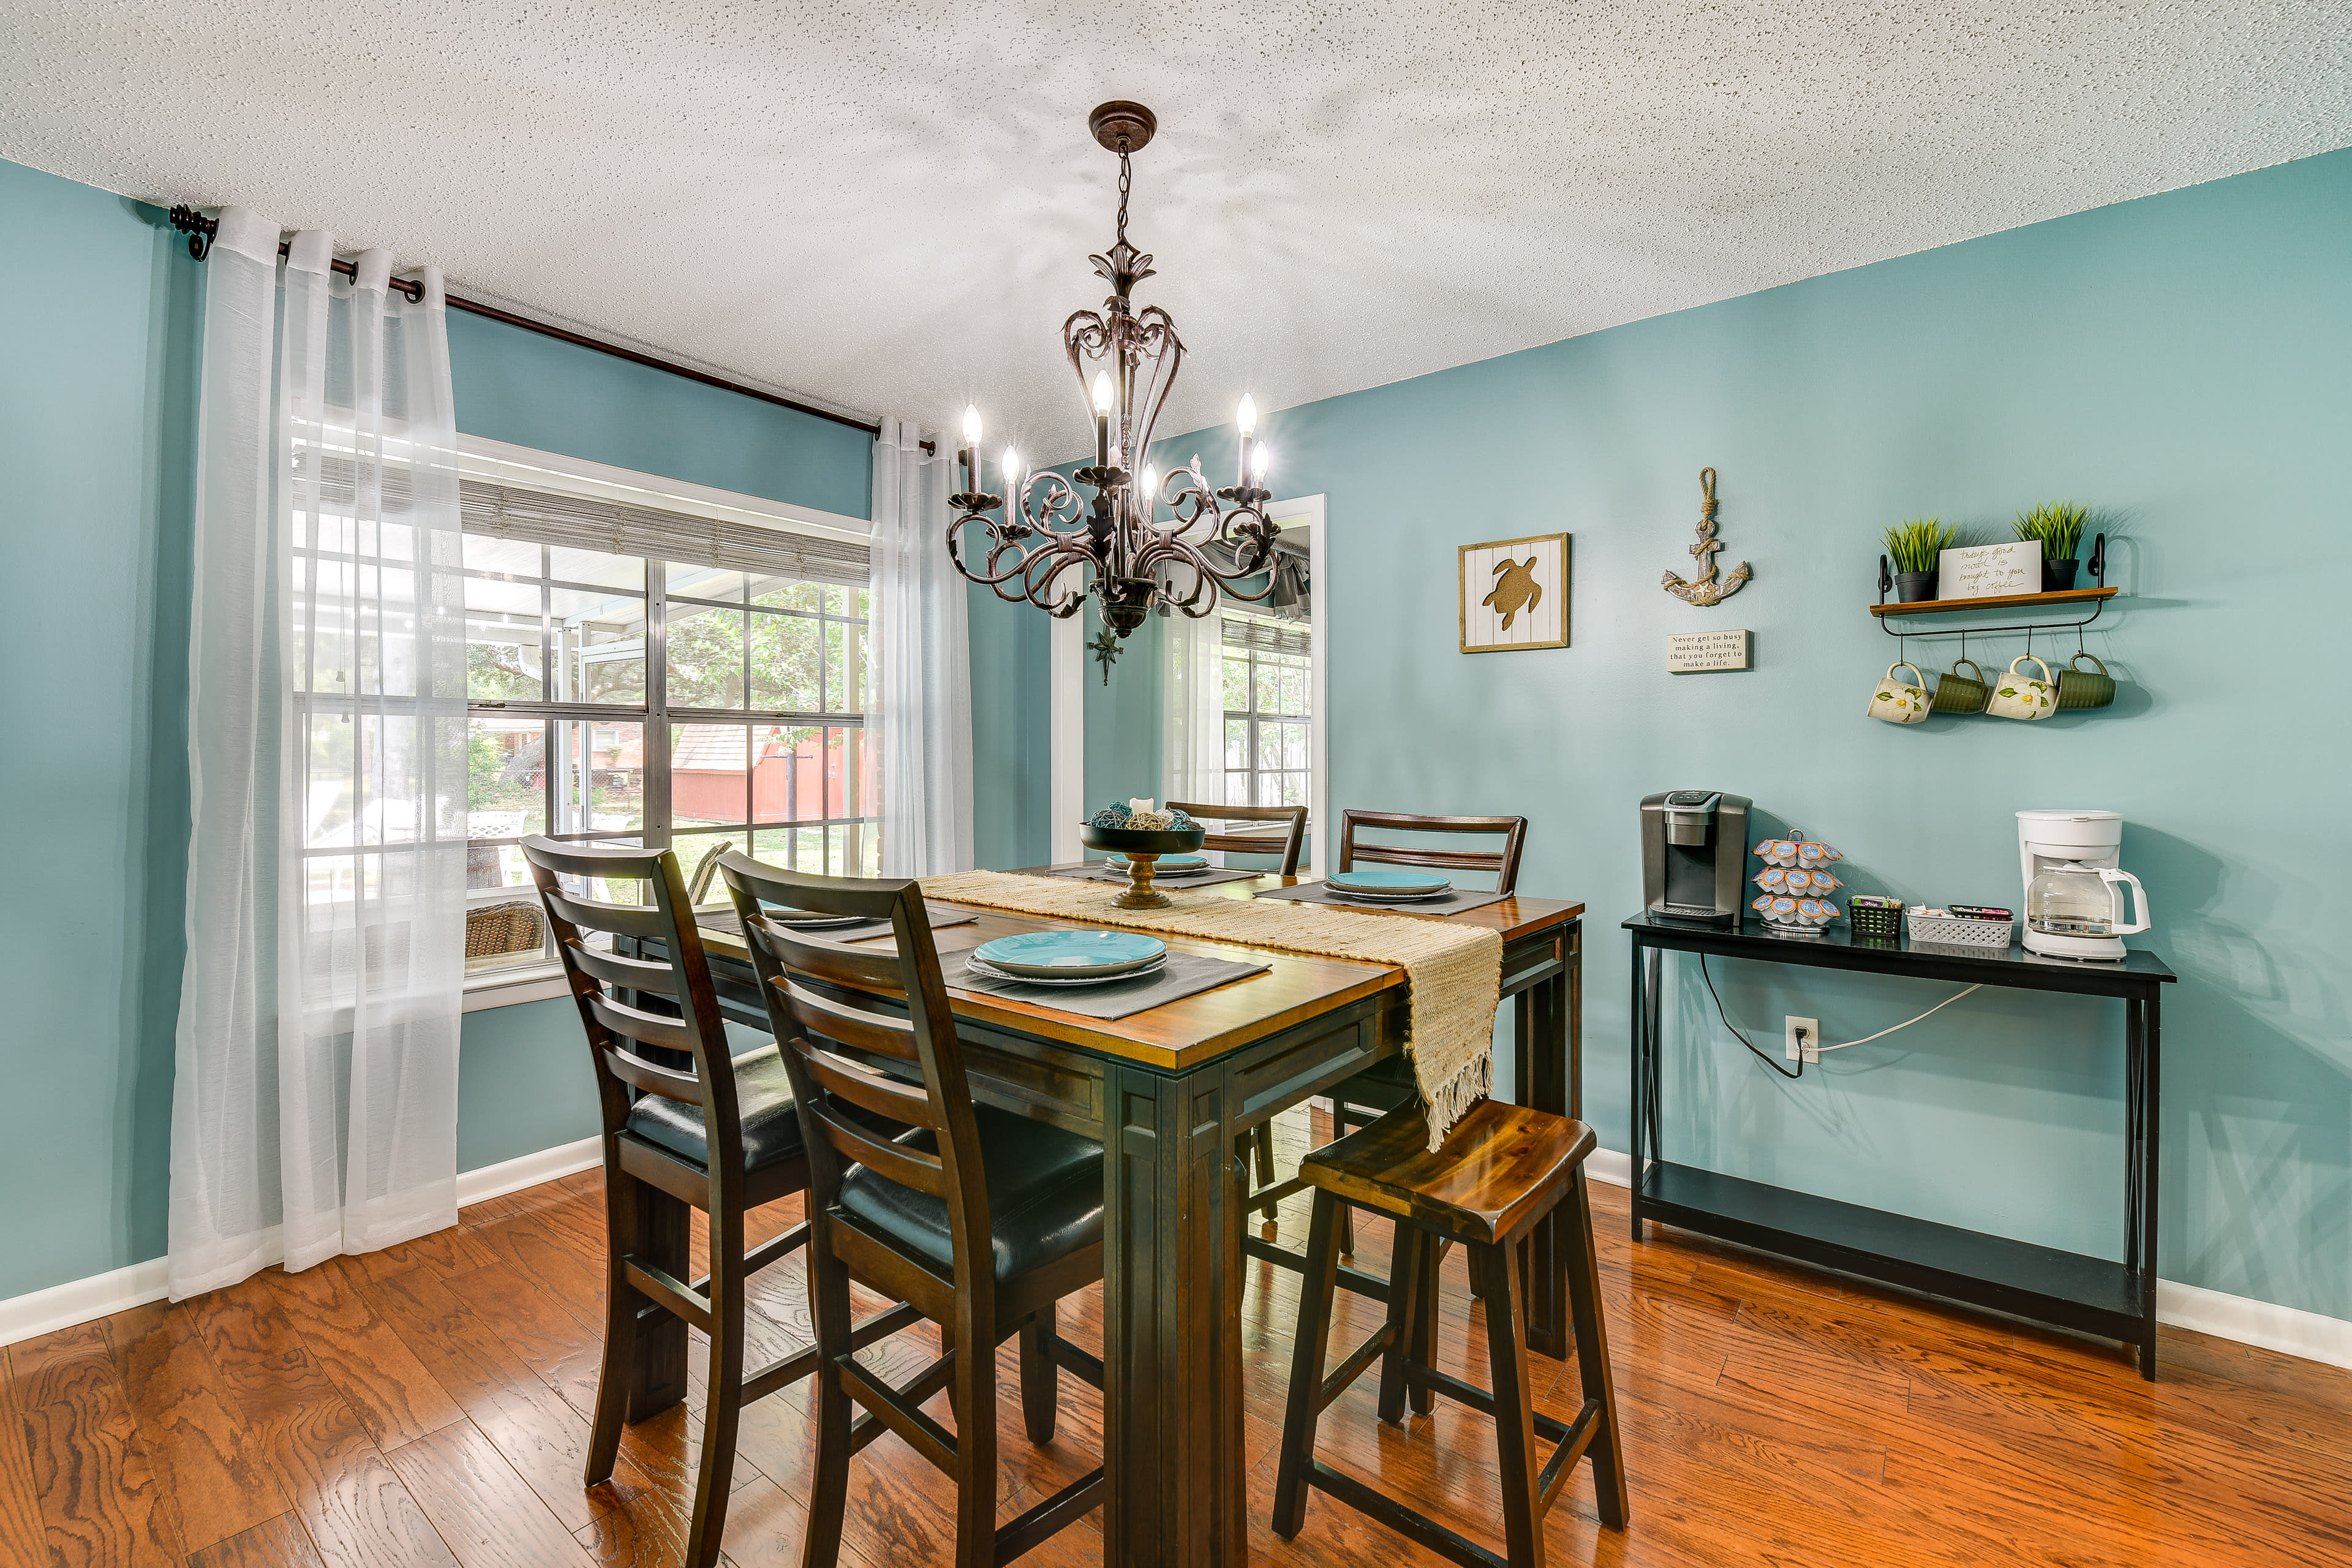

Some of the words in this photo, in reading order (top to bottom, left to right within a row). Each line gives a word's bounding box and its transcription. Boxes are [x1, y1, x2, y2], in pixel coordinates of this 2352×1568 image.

[1960, 549, 1989, 562] today's
[1961, 557, 1991, 570] mood
[1959, 570, 1990, 584] brought
[2007, 568, 2025, 579] you
[1967, 582, 1978, 596] by
[1986, 580, 2024, 594] coffee
